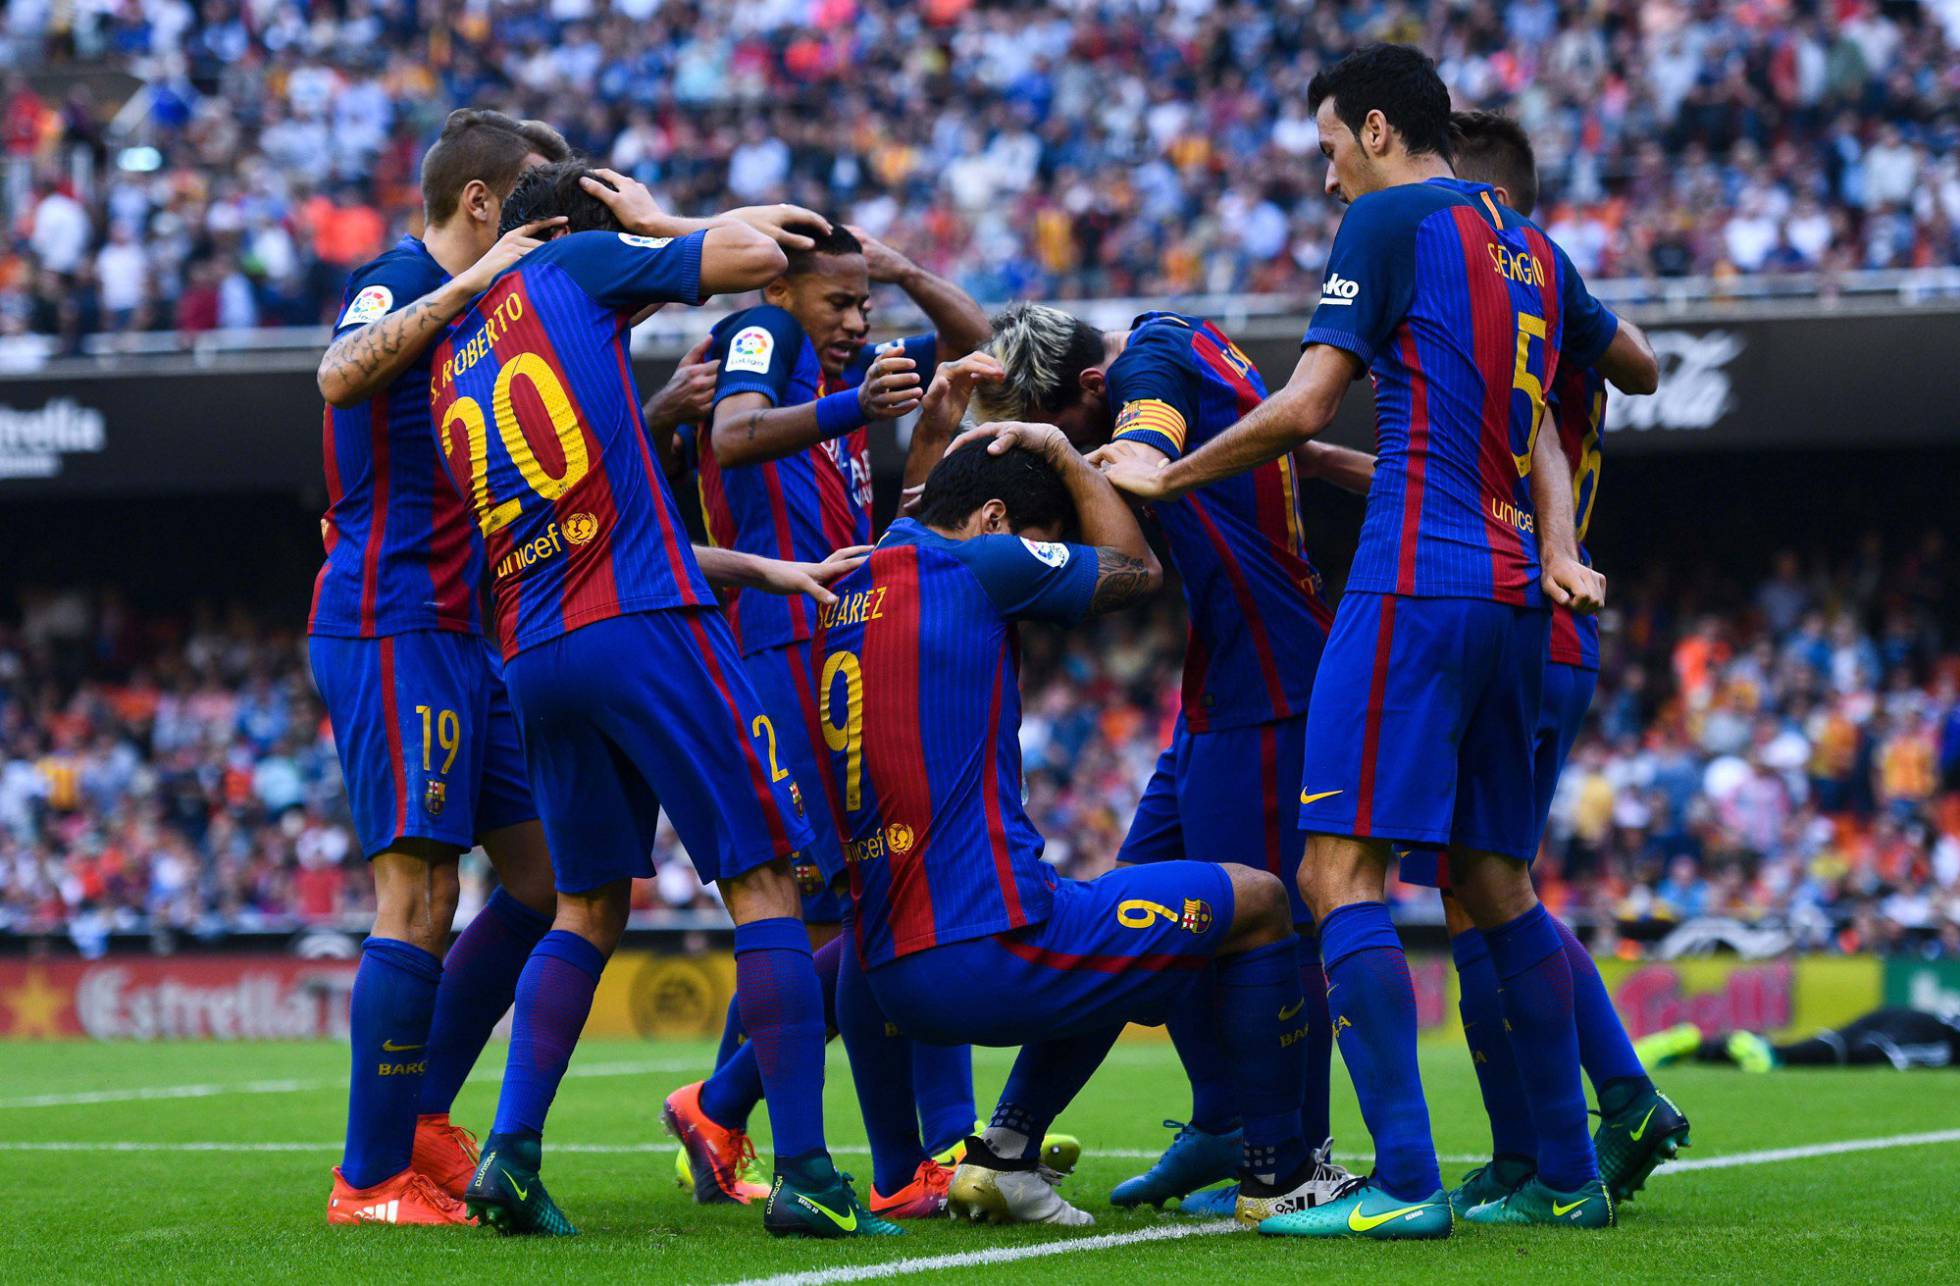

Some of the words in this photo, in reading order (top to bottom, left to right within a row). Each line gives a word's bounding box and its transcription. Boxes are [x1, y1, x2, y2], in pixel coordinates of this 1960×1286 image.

[1322, 272, 1360, 299] ko
[442, 292, 523, 388] ROBERTO
[1512, 311, 1547, 478] 5
[441, 352, 589, 540] 20
[497, 522, 561, 578] unicef
[416, 705, 460, 774] 19
[752, 714, 789, 783] 2
[820, 650, 863, 812] 9
[1117, 899, 1179, 929] 9
